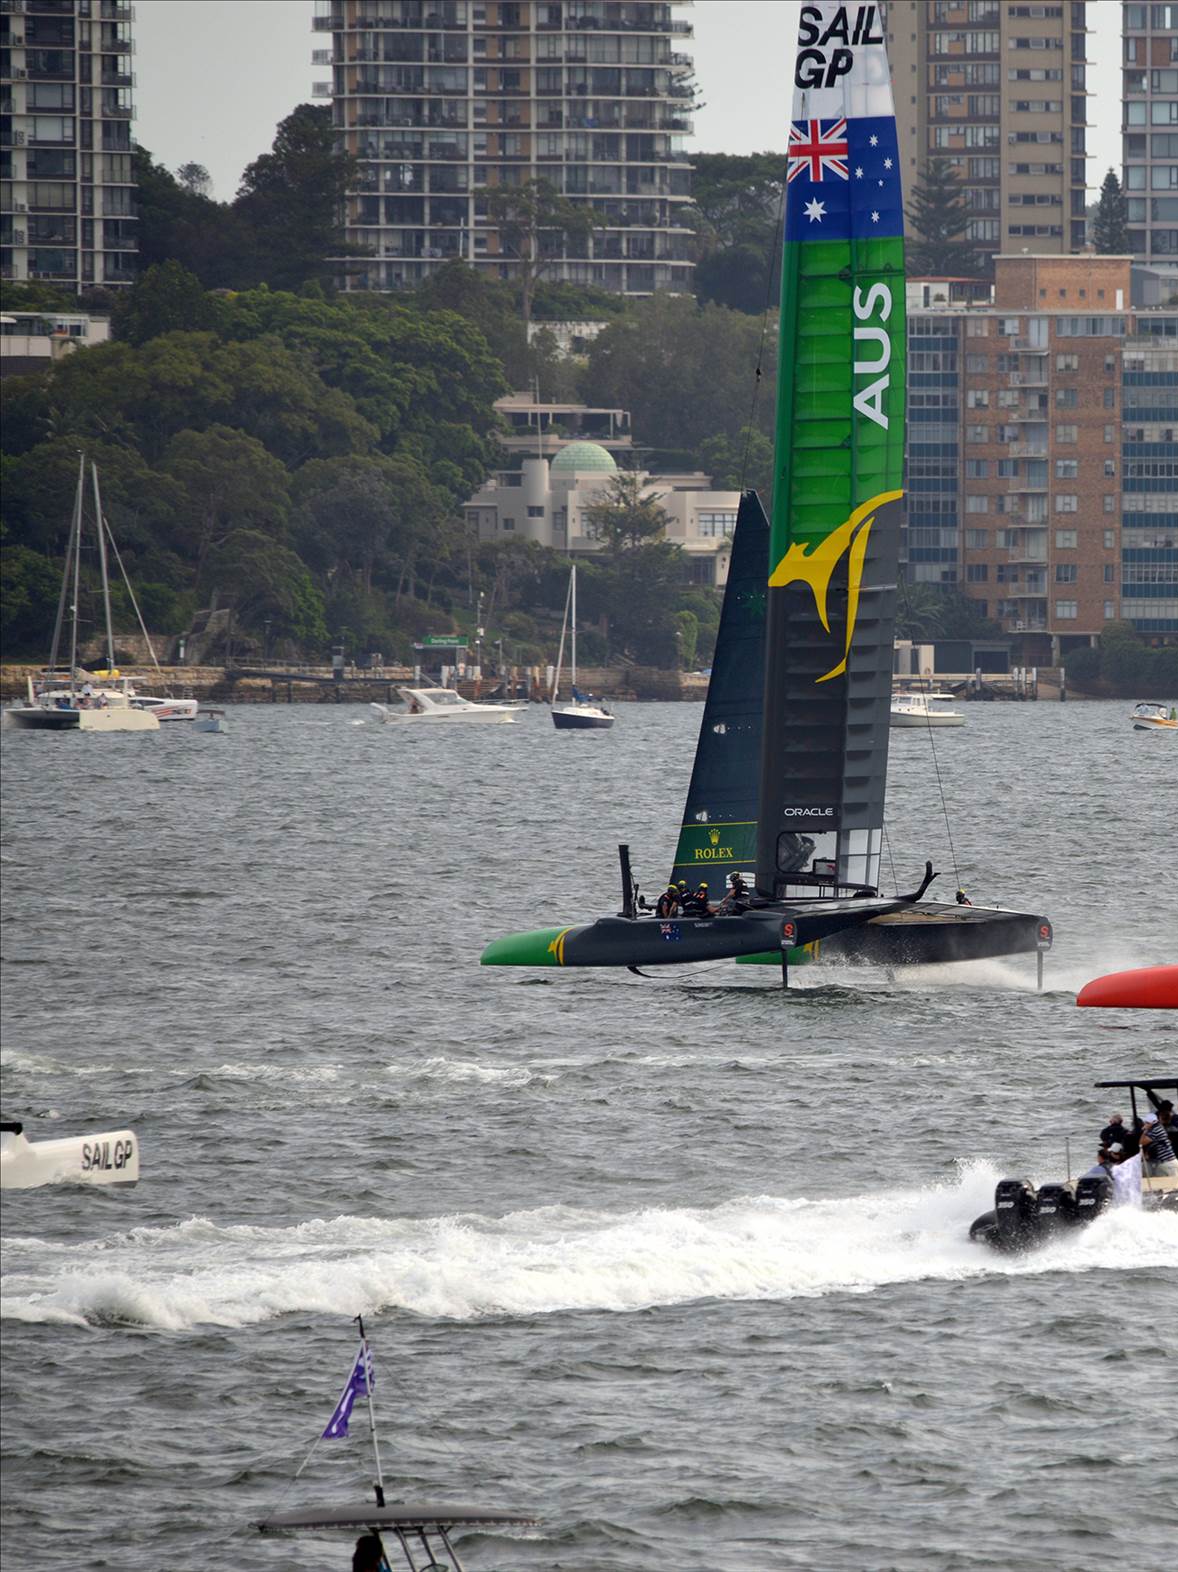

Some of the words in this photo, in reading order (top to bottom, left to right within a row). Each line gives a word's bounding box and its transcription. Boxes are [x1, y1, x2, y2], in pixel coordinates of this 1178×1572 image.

[798, 6, 884, 47] SAIL
[794, 49, 853, 89] GP
[853, 282, 893, 430] AUS
[784, 808, 833, 817] ORACLE
[694, 847, 734, 860] ROLEX
[81, 1143, 112, 1171] SAIL
[114, 1140, 133, 1169] GP
